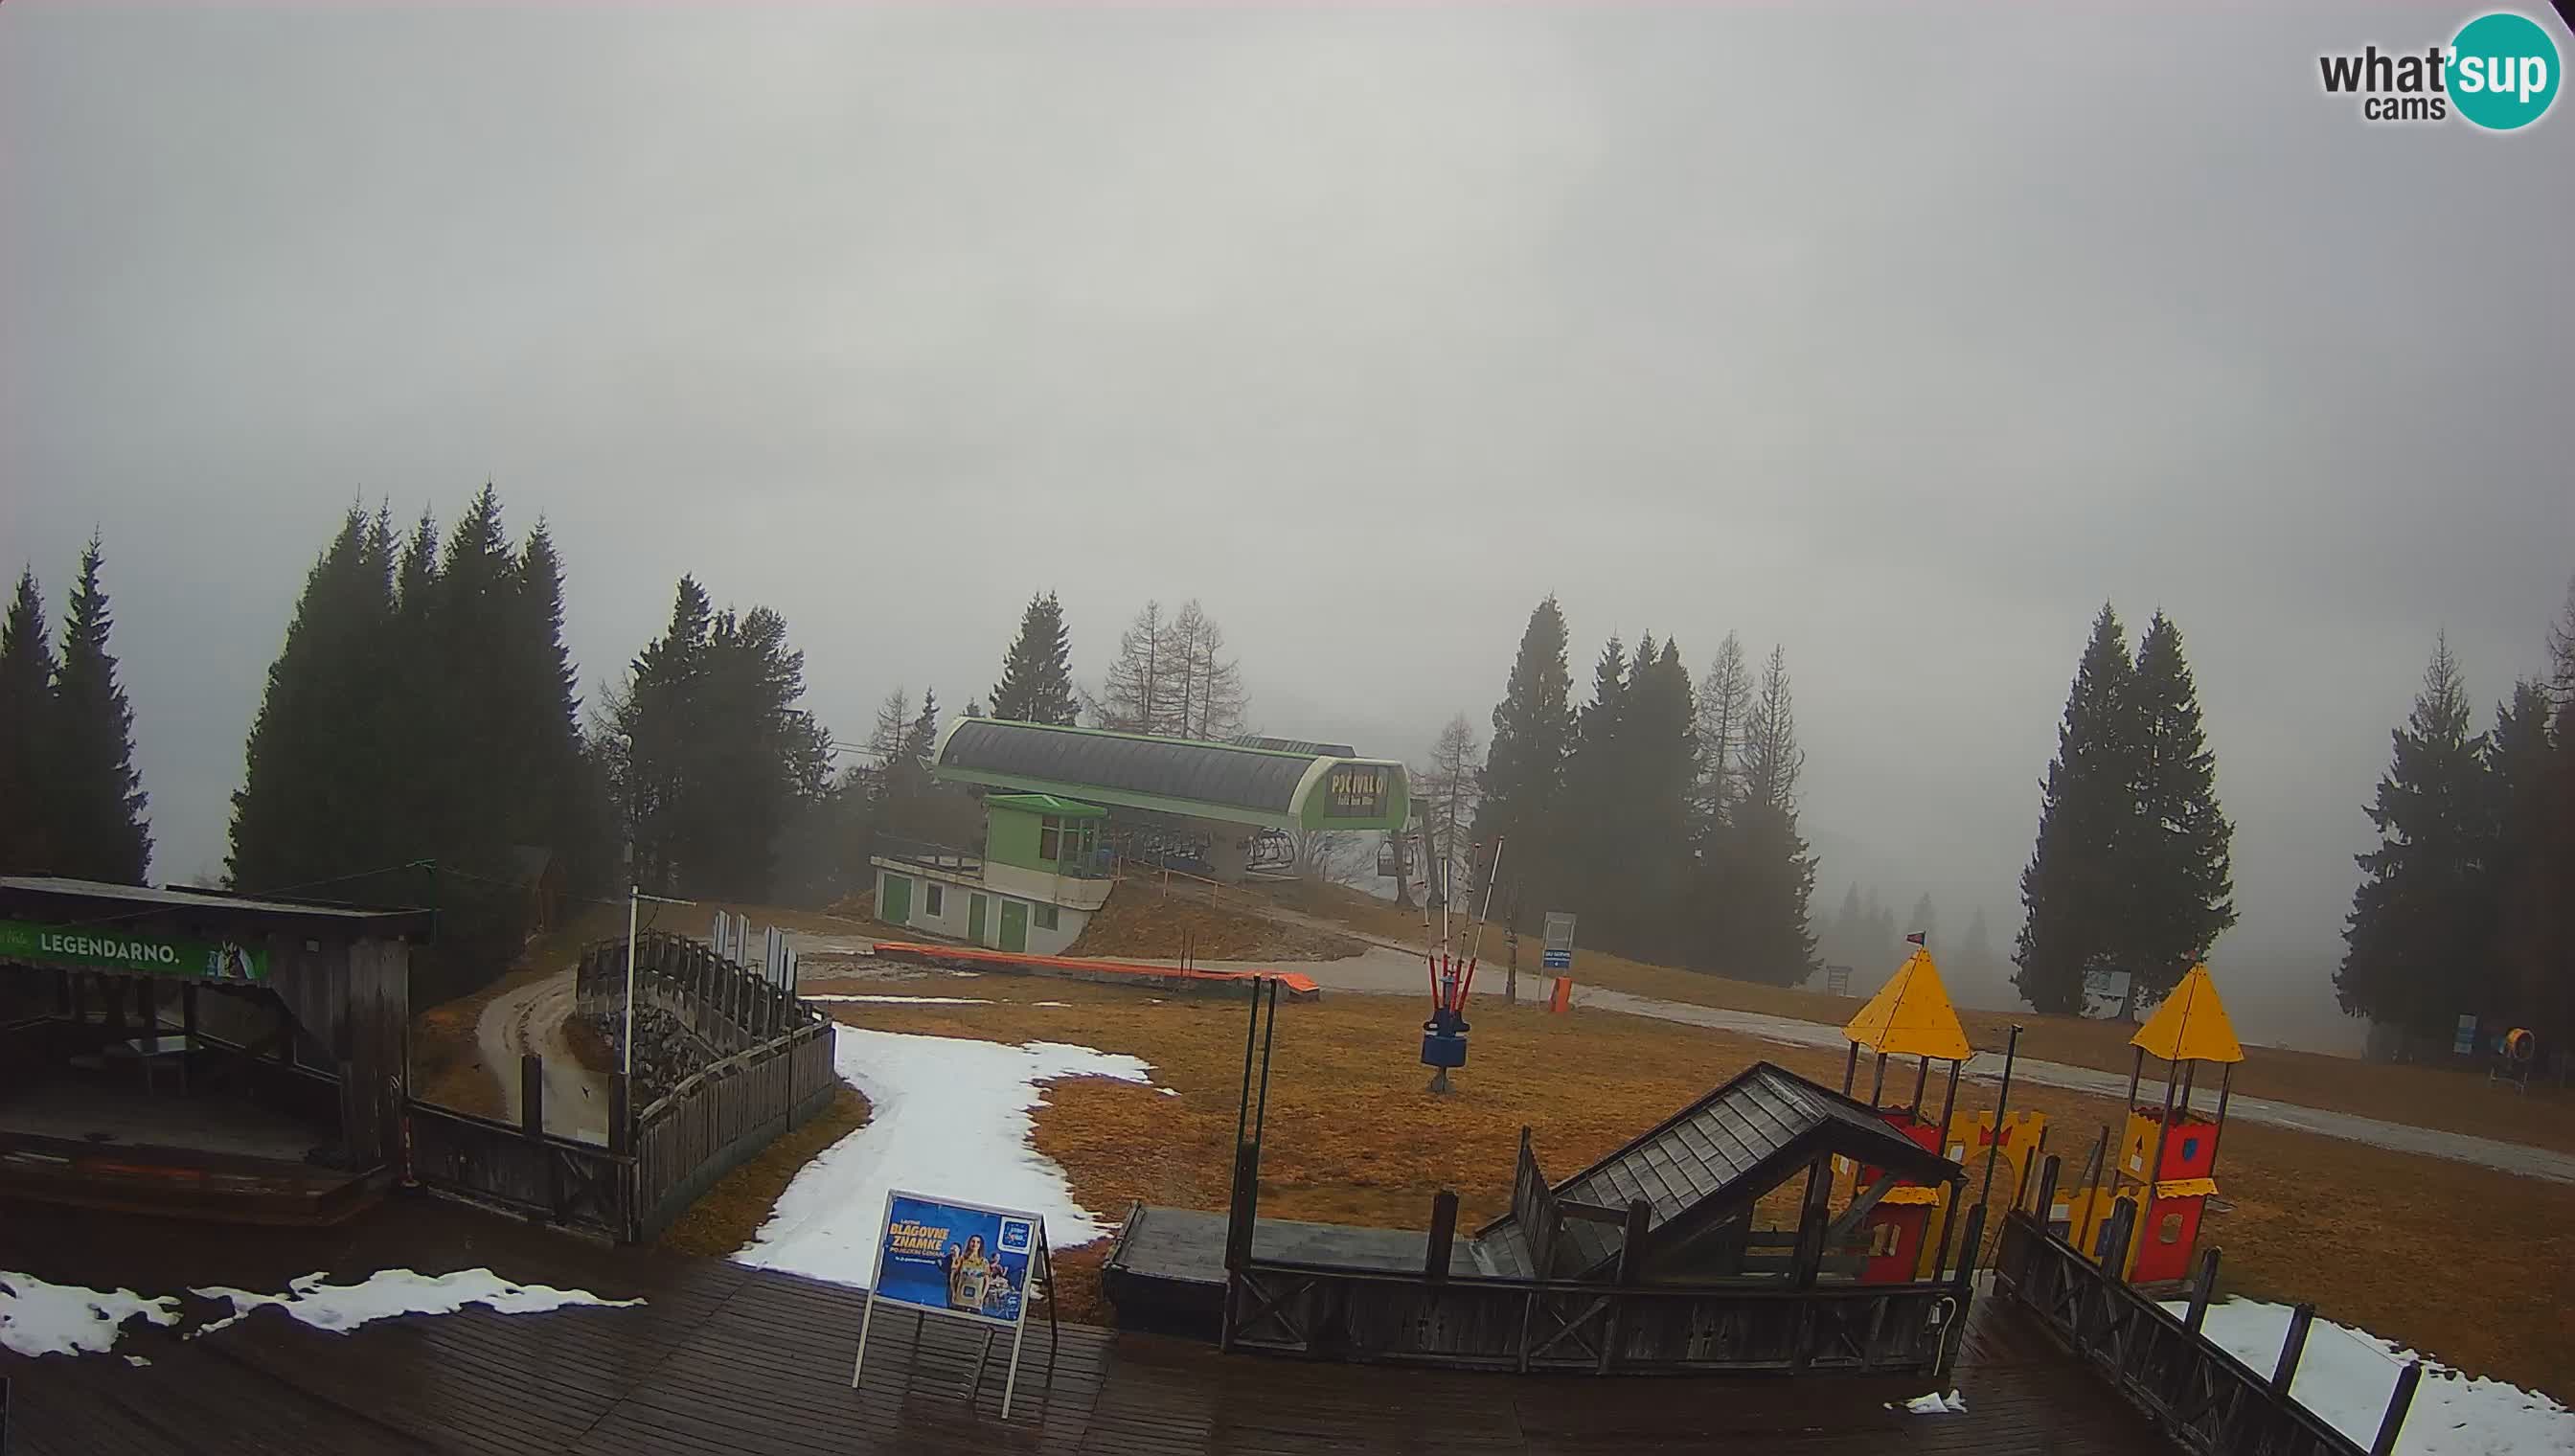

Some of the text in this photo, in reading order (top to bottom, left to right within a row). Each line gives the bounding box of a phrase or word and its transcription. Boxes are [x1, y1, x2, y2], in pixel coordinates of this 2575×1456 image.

[40, 933, 181, 965] LEGENDARNO.
[889, 1222, 950, 1240] BLAGOVNE
[892, 1236, 944, 1251] ZNAMKE
